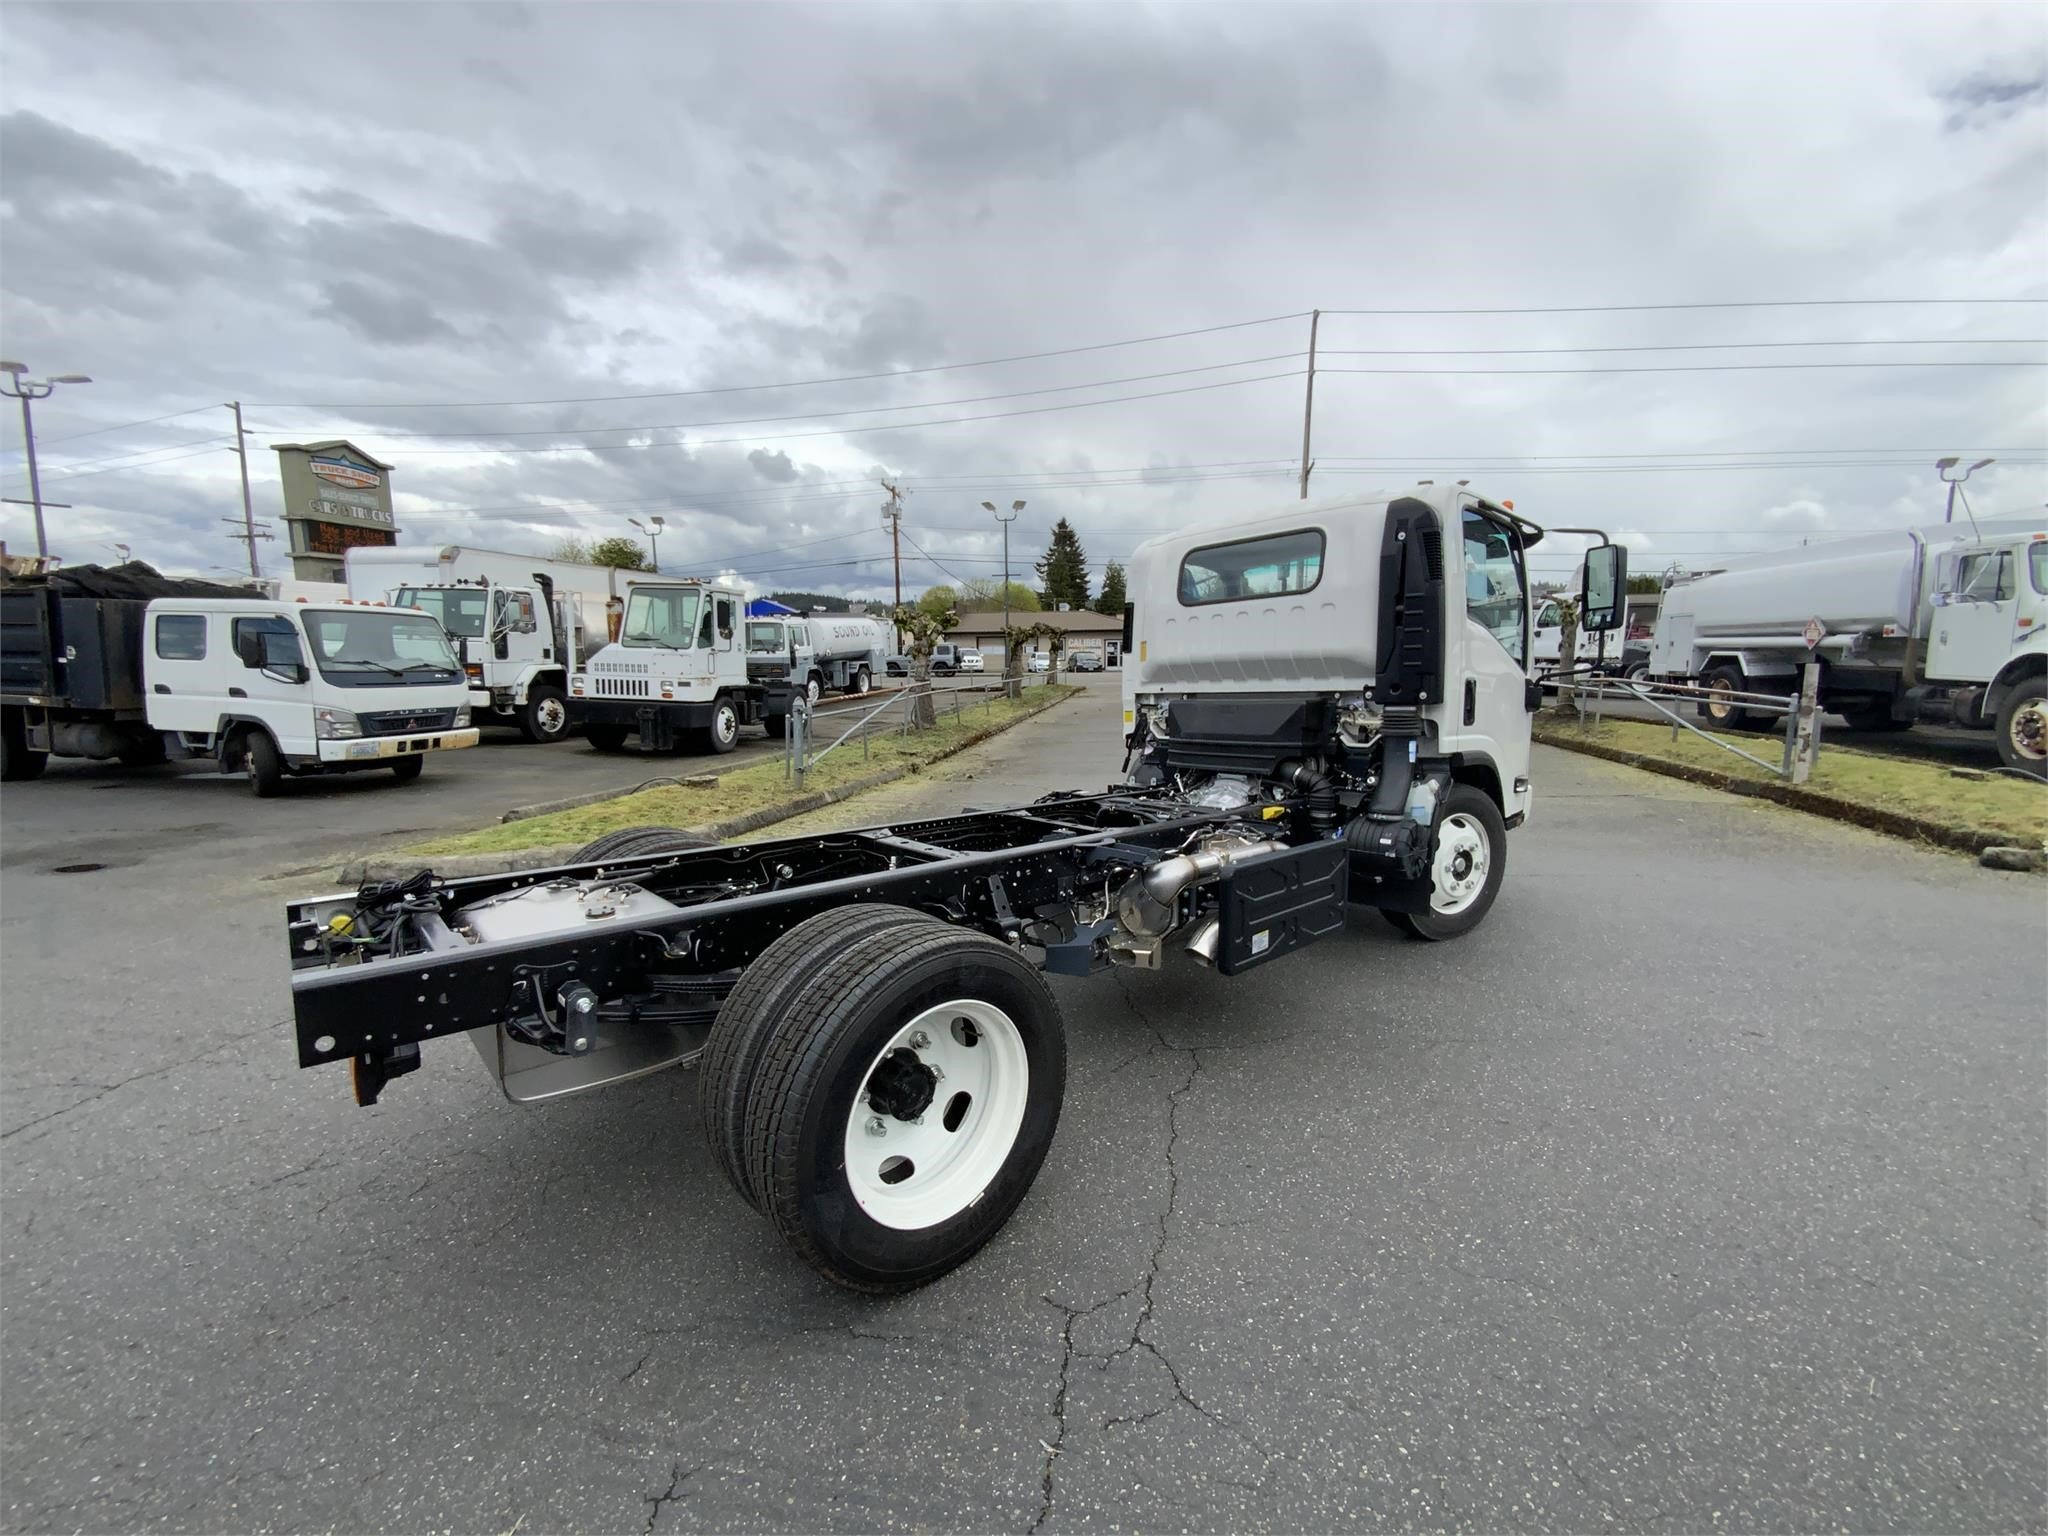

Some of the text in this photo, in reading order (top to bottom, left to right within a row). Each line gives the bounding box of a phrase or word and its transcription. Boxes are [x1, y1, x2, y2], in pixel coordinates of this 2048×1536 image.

[313, 464, 379, 483] TRUCK SHOP
[308, 499, 338, 515] CARS
[351, 506, 391, 523] TRUCKS
[833, 625, 875, 639] SOUND OIL
